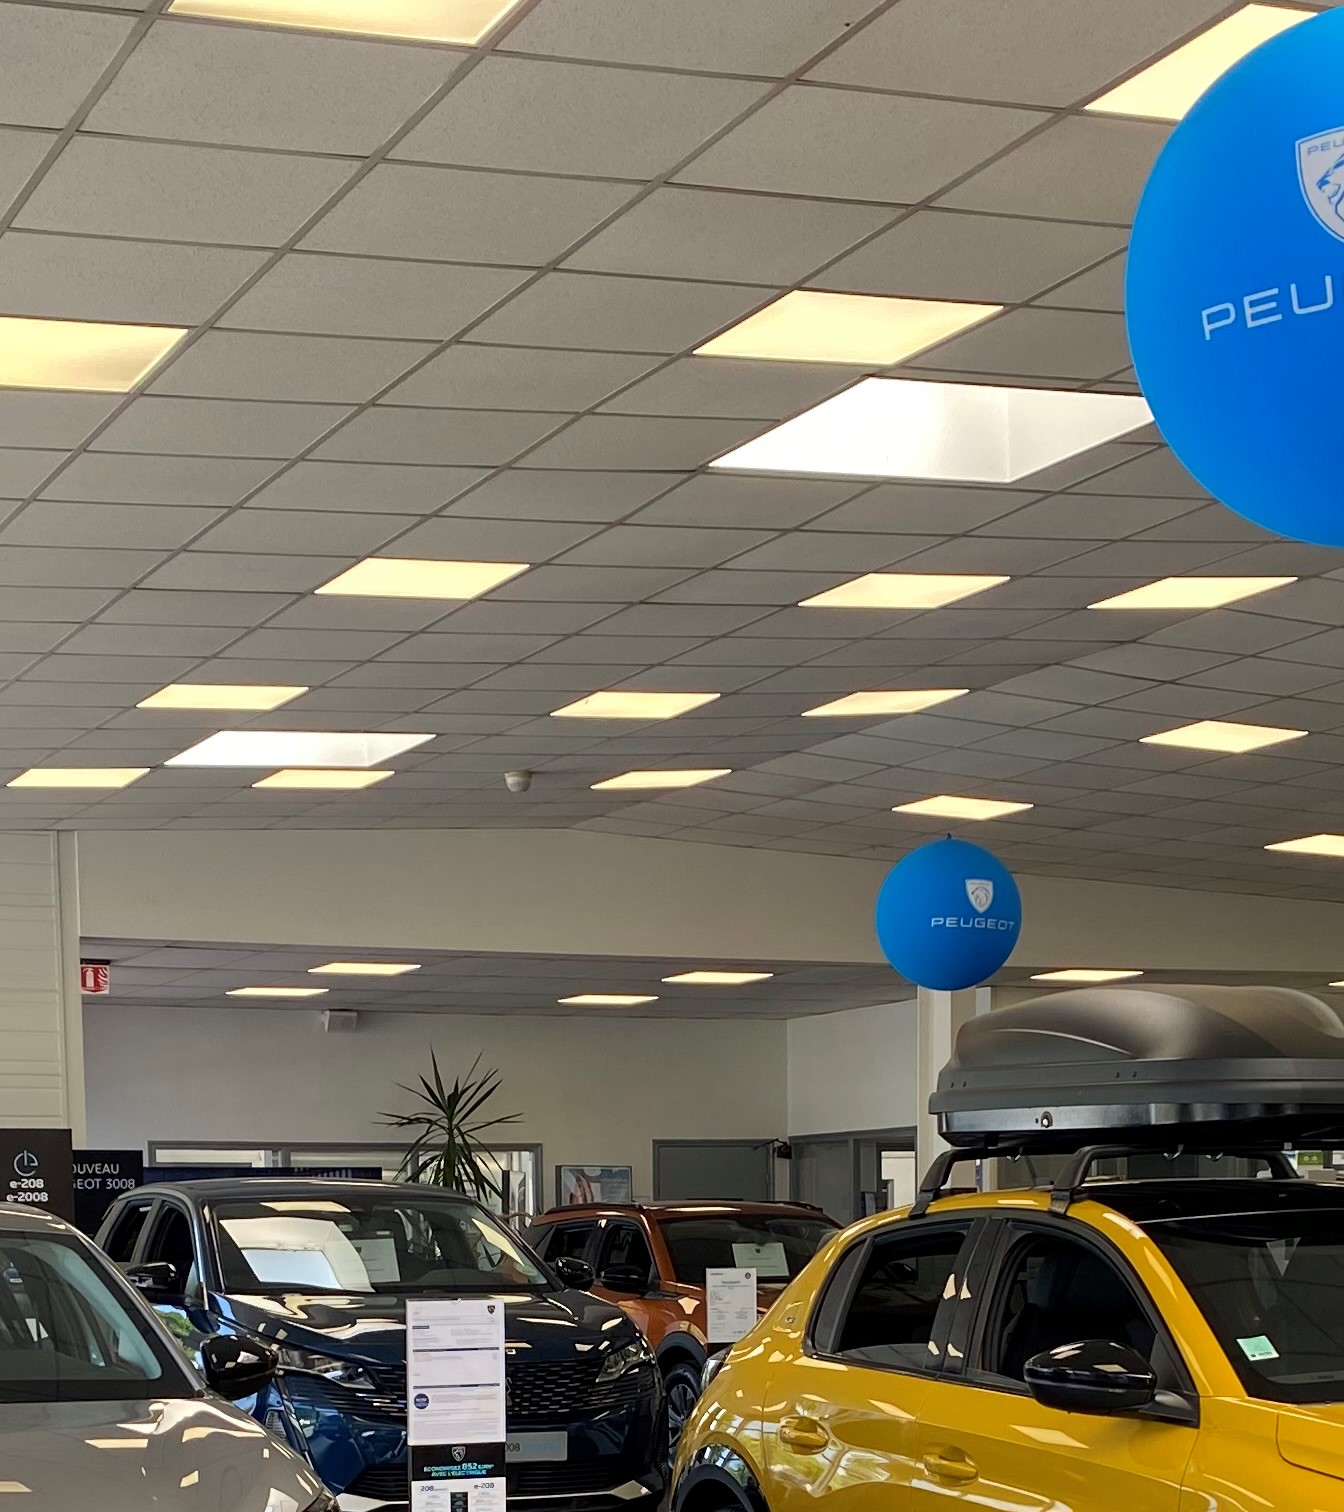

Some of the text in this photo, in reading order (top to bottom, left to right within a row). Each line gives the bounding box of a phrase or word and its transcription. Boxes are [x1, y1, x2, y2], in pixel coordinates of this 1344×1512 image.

[930, 917, 1016, 931] PEUGEOT
[9, 1178, 45, 1189] e-208
[105, 1178, 136, 1190] 3008
[6, 1191, 49, 1203] e-2008
